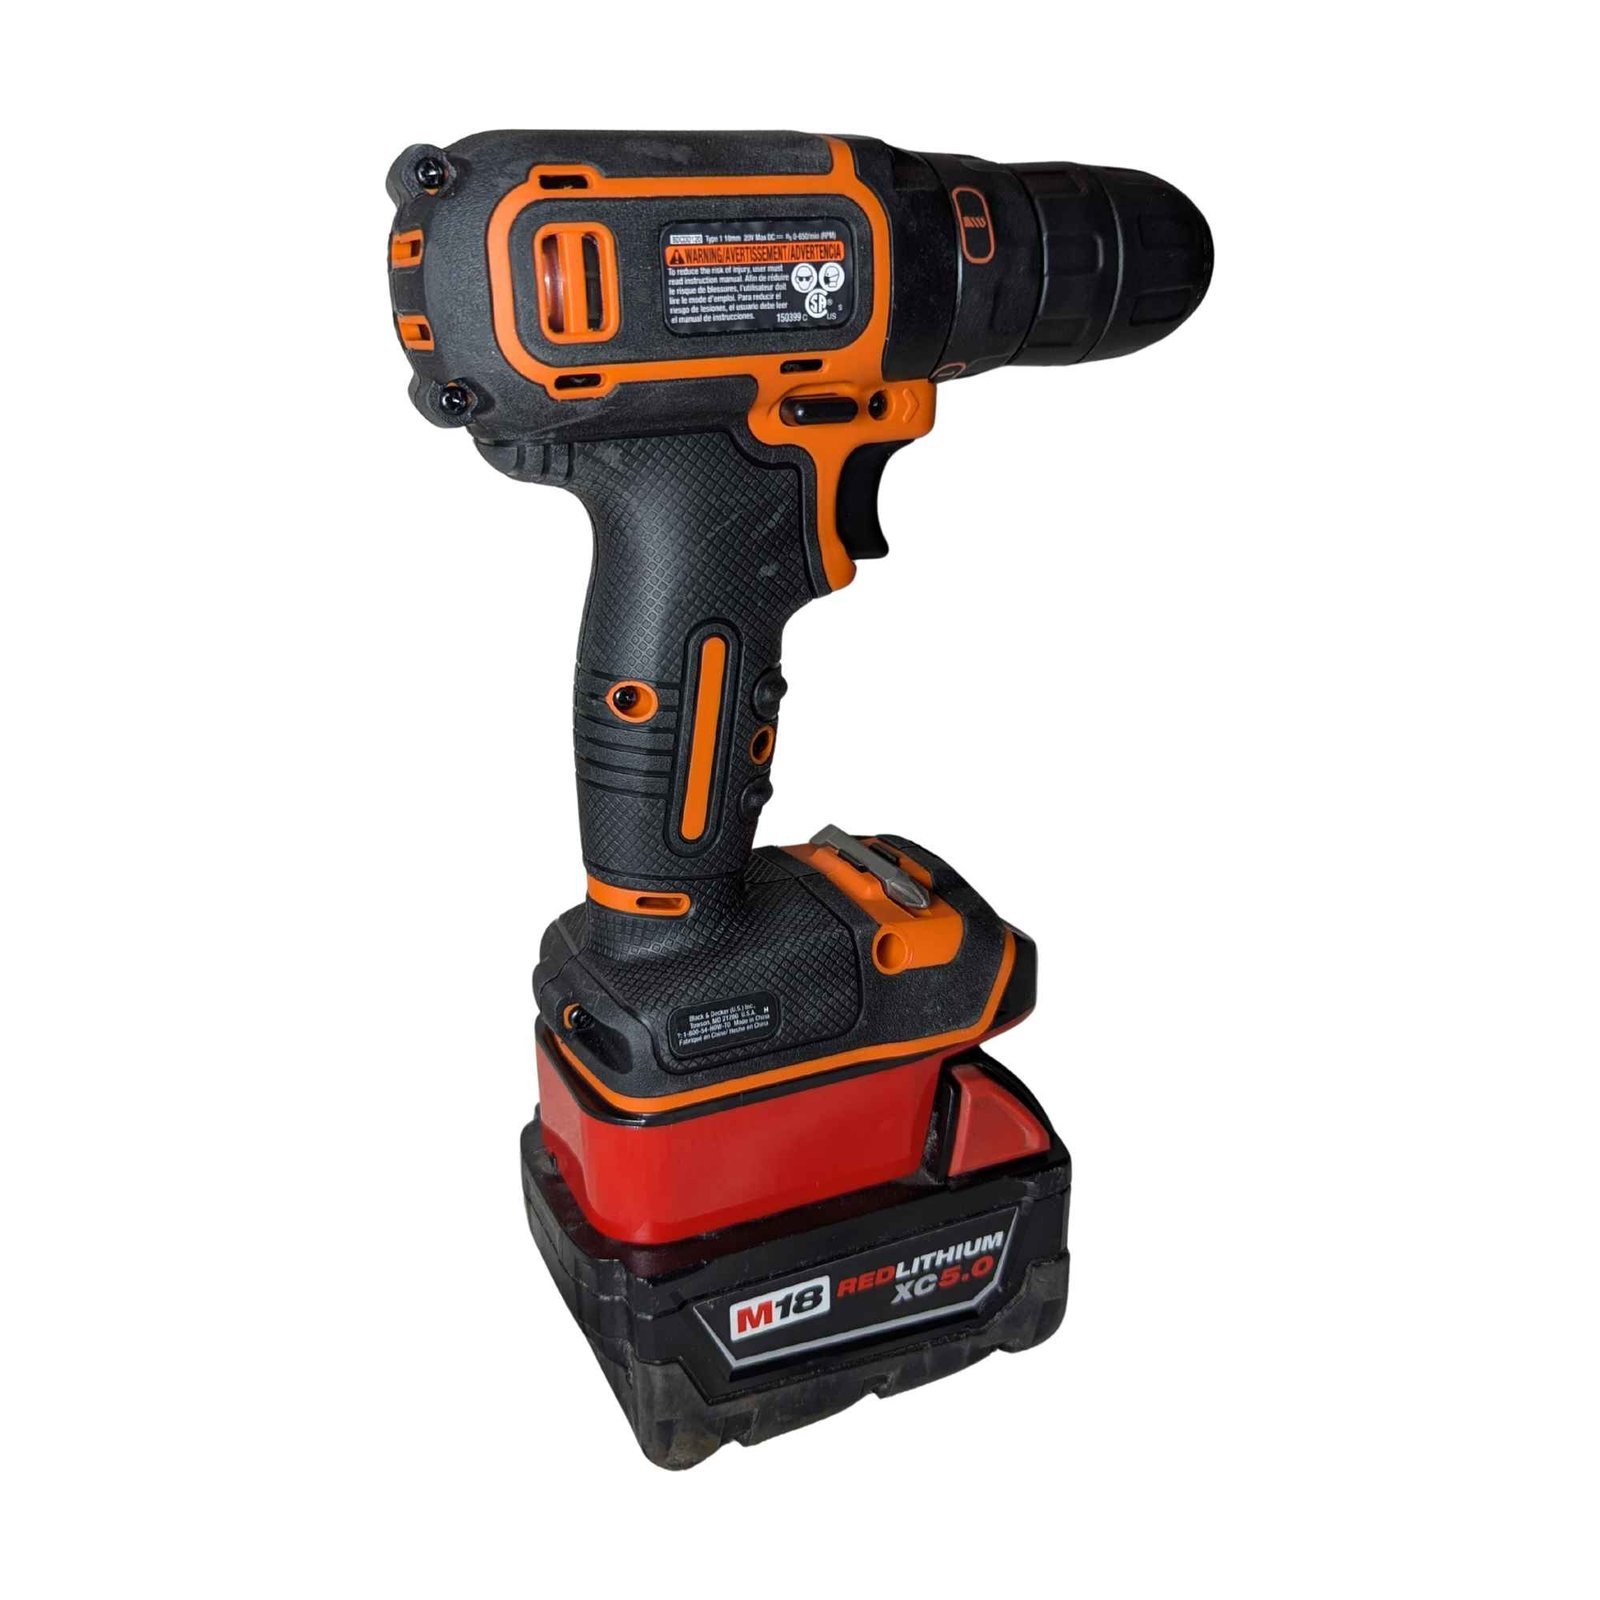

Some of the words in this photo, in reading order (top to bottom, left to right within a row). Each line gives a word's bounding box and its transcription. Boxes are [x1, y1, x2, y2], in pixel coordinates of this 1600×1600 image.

[705, 235, 718, 244] Type
[820, 231, 836, 240] (RPM)
[684, 244, 841, 264] WARNING/AVERTISSEMENT/ADVERTENCIA
[732, 266, 750, 274] injury,
[676, 286, 696, 296] risque
[707, 285, 739, 294] blessures,
[740, 284, 774, 292] l'utilisateur
[681, 296, 688, 304] le
[708, 294, 736, 304] d'emploi.
[670, 306, 690, 315] riesgo
[700, 304, 728, 313] lesiones,
[671, 316, 678, 324] el
[678, 315, 702, 323] manual
[712, 312, 756, 322] instrucciones.
[776, 312, 802, 322] 150399
[710, 1010, 728, 1018] Decker
[754, 1020, 768, 1028] China
[836, 1230, 1004, 1298] REDLITHIUM
[890, 1254, 996, 1305] XC5.0
[736, 1284, 824, 1334] M18
